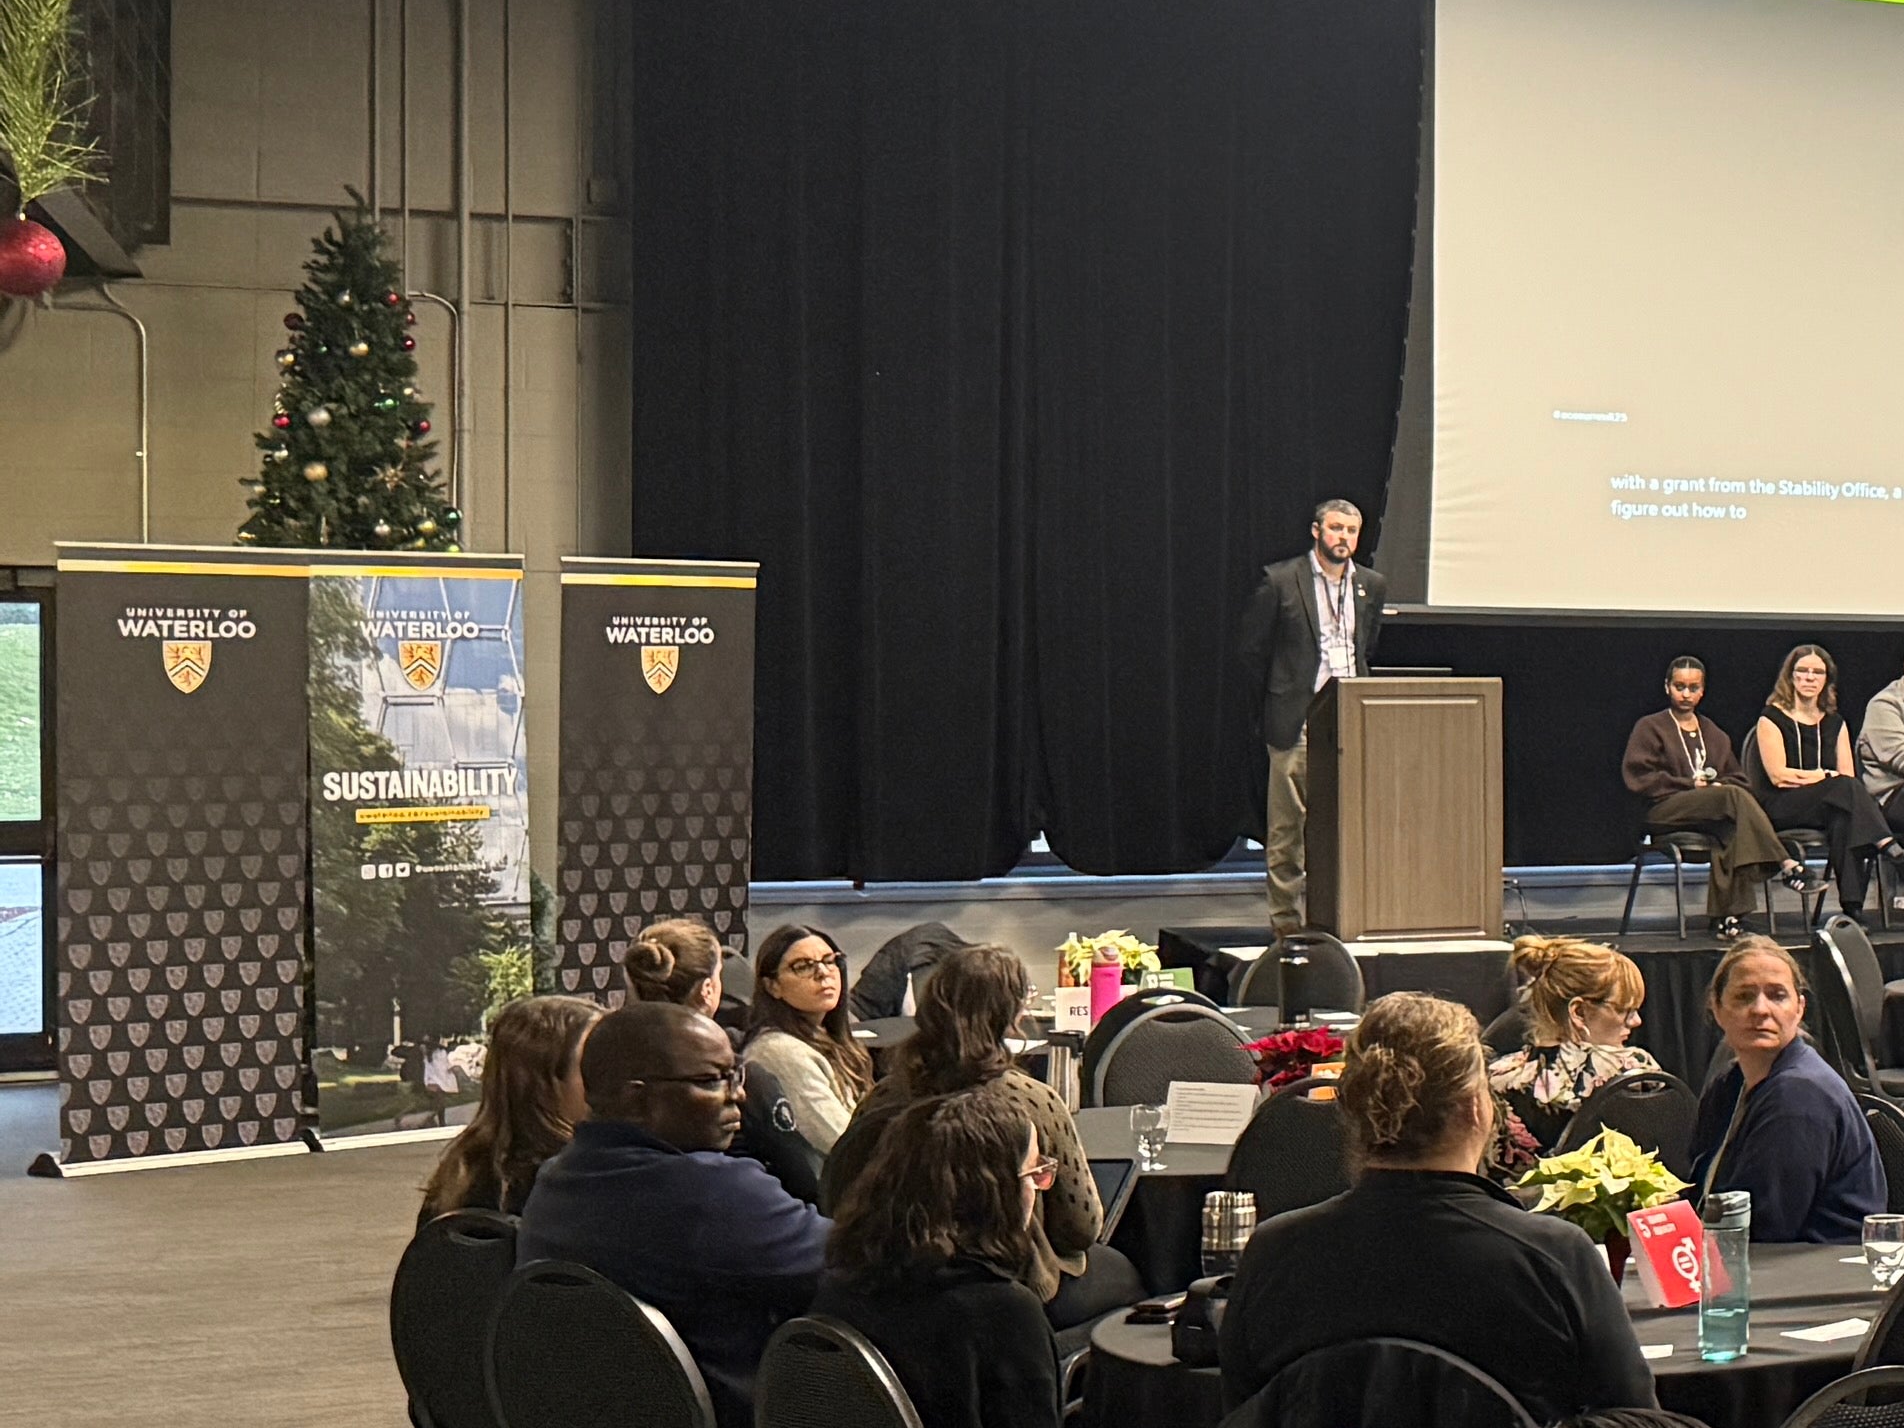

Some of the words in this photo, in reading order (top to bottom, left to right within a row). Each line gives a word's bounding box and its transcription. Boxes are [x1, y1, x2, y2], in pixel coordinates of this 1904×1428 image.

[1611, 474, 1645, 489] with
[1649, 478, 1659, 490] a
[1663, 478, 1705, 494] grant
[1709, 477, 1745, 493] from
[1749, 479, 1775, 494] the
[1778, 480, 1839, 500] Stability
[1841, 482, 1889, 500] Office,
[1893, 487, 1902, 499] a
[1611, 500, 1658, 519] figure
[1661, 503, 1688, 517] out
[1692, 503, 1726, 518] how
[1729, 505, 1747, 519] to
[126, 607, 221, 618] UNIVERSITY
[228, 609, 247, 618] OF
[367, 610, 447, 620] UNIVERSITY
[454, 611, 470, 620] OF
[612, 616, 687, 626] UNIVERSITY
[692, 617, 708, 626] OF
[117, 619, 257, 639] WATERLOO
[361, 621, 479, 639] WATERLOO
[605, 626, 715, 644] WATERLOO
[323, 768, 517, 801] SUSTAINABILITY
[1636, 1217, 1652, 1239] 5
